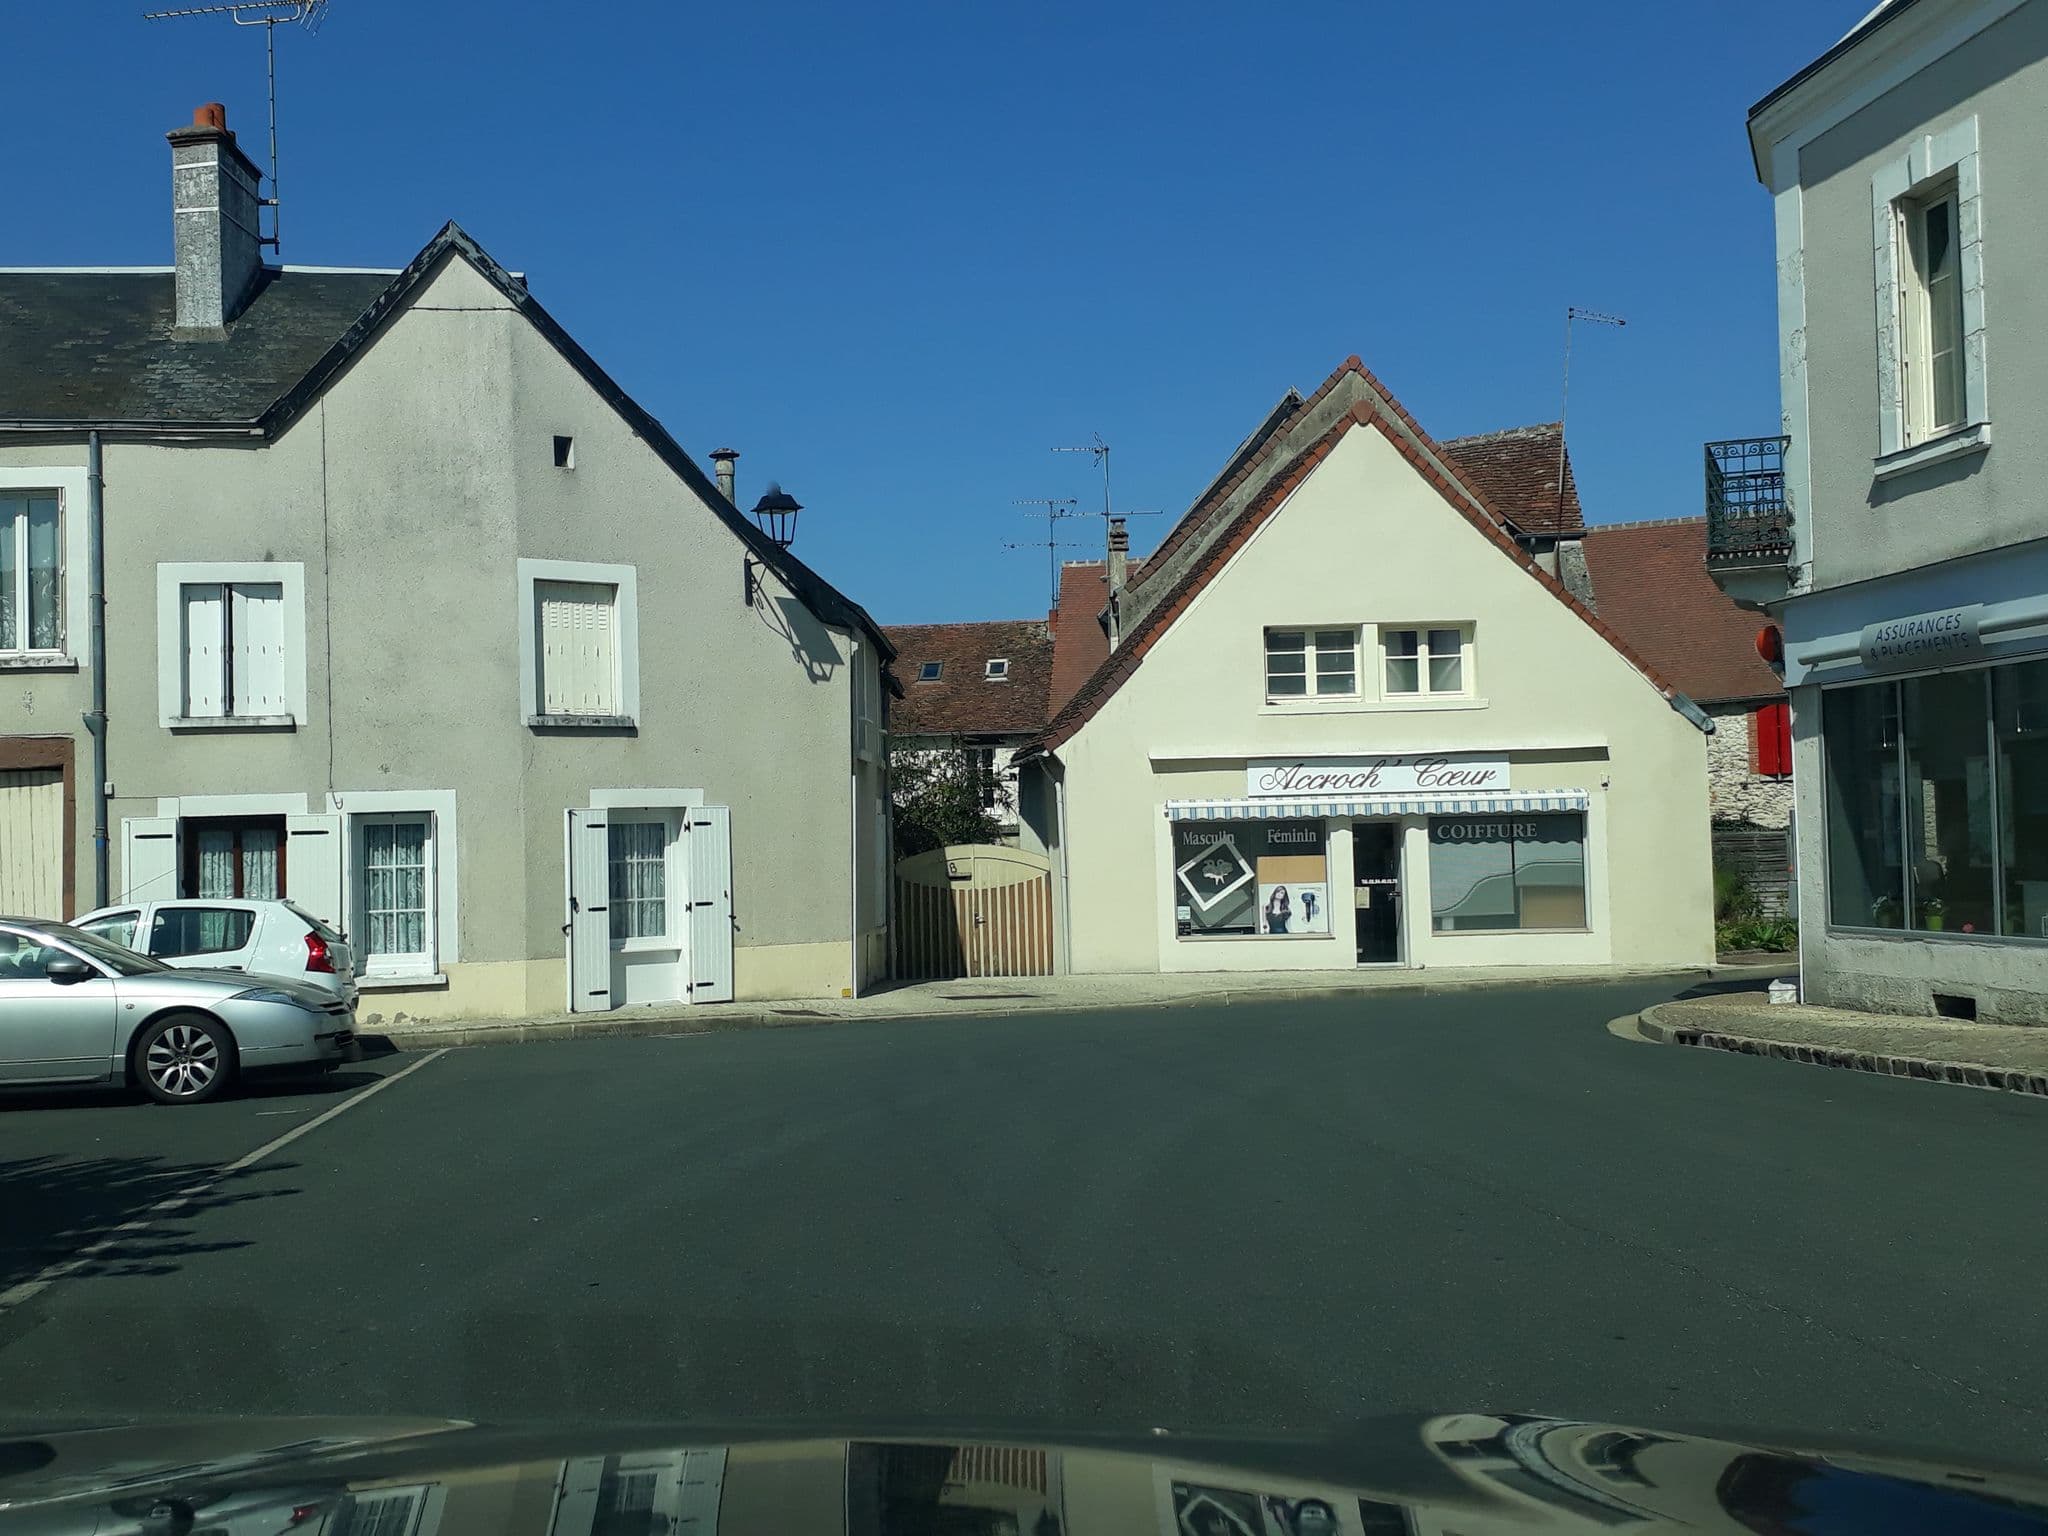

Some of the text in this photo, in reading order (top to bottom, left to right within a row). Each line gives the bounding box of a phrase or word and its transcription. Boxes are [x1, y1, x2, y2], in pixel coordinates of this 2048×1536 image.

[1875, 613, 1962, 644] ASSURANCES
[1870, 632, 1969, 662] & PLACEMENTS
[1183, 830, 1235, 846] Masculin
[1267, 827, 1317, 843] Féminin
[1437, 823, 1538, 839] COIFFURE
